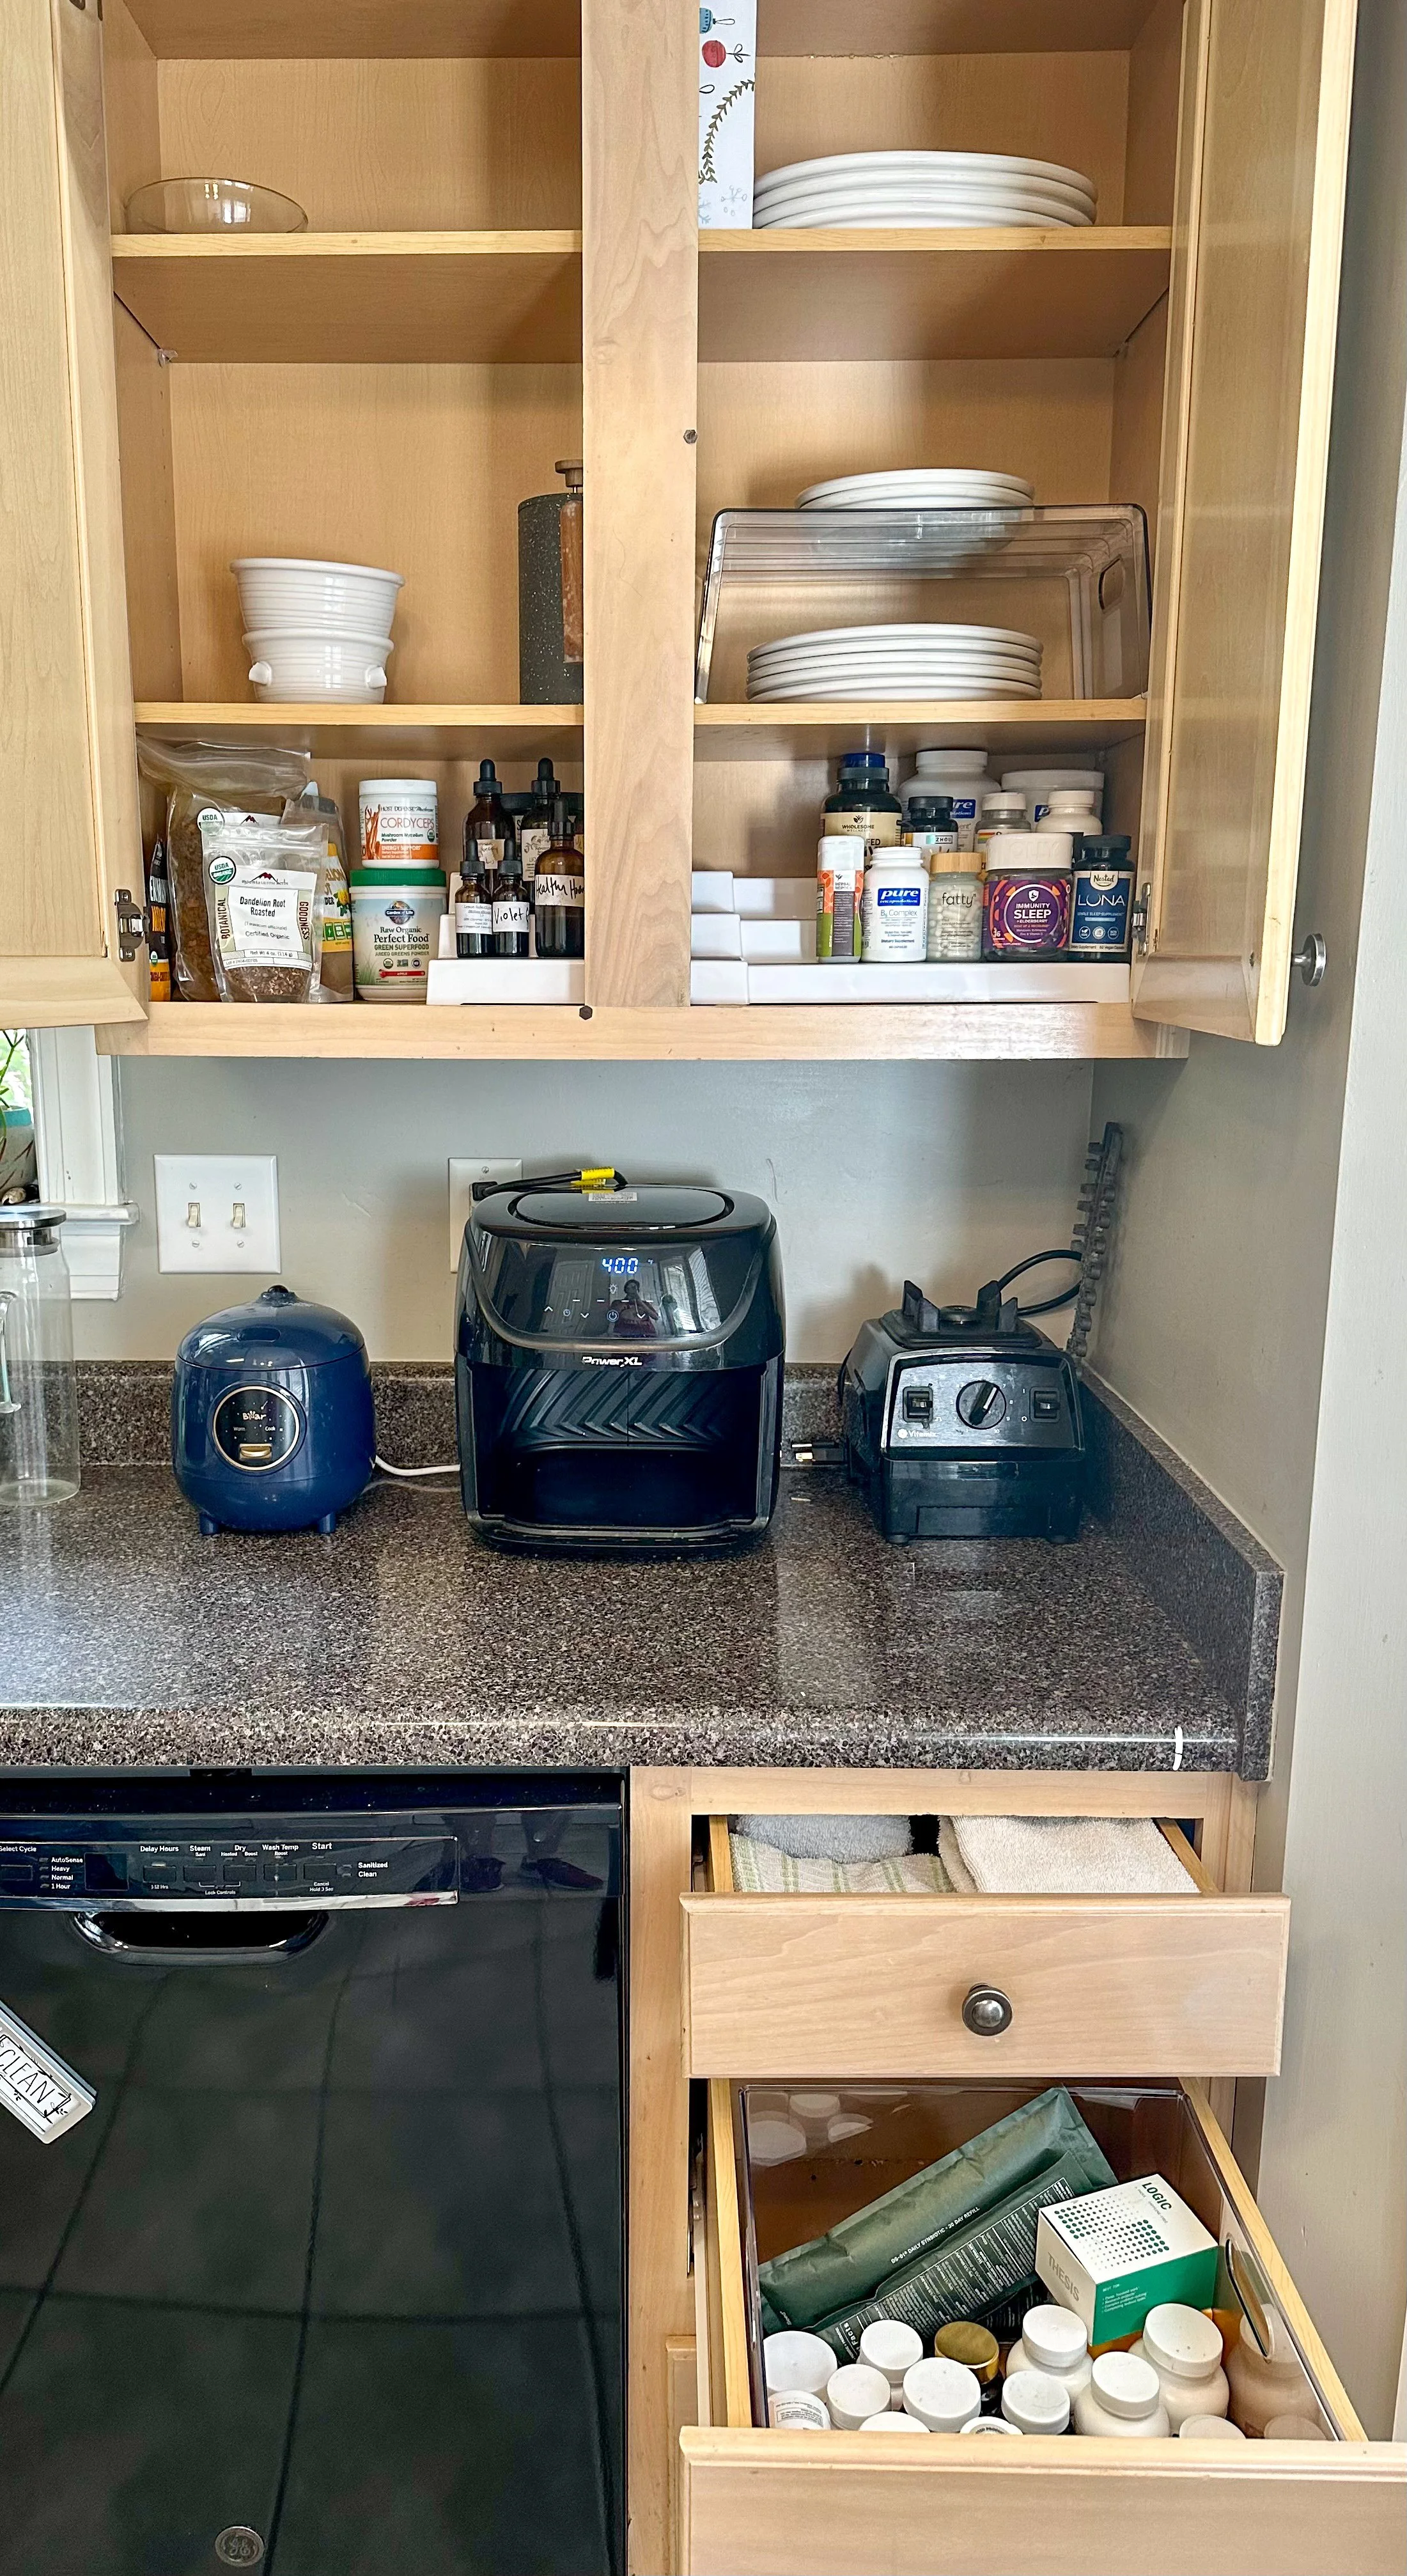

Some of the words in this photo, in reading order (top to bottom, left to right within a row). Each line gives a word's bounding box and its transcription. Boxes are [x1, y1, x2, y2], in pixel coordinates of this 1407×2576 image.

[380, 818, 435, 829] CORDYCEPS
[240, 896, 271, 907] Dandelion
[273, 899, 286, 908] Root
[881, 890, 919, 900] pure
[1078, 894, 1126, 907] LUNA
[218, 898, 231, 939] BOTANICAL
[251, 907, 276, 917] Roasted
[494, 907, 524, 924] Violet
[1014, 909, 1052, 919] SLEEP
[299, 902, 310, 941] GOODNESS
[374, 934, 407, 942] Perfect
[408, 934, 430, 942] Food
[396, 926, 422, 934] Organic
[602, 1258, 638, 1274] 400
[0, 2049, 56, 2104] CLEAN
[1142, 2182, 1172, 2210] LOGIC
[908, 2242, 921, 2254] DAILY
[921, 2228, 945, 2245] SYNBIOTIC
[954, 2216, 964, 2225] DAY
[964, 2206, 980, 2219] REFILL
[1048, 2252, 1080, 2302] THESIS
[843, 2322, 858, 2346] Facts
